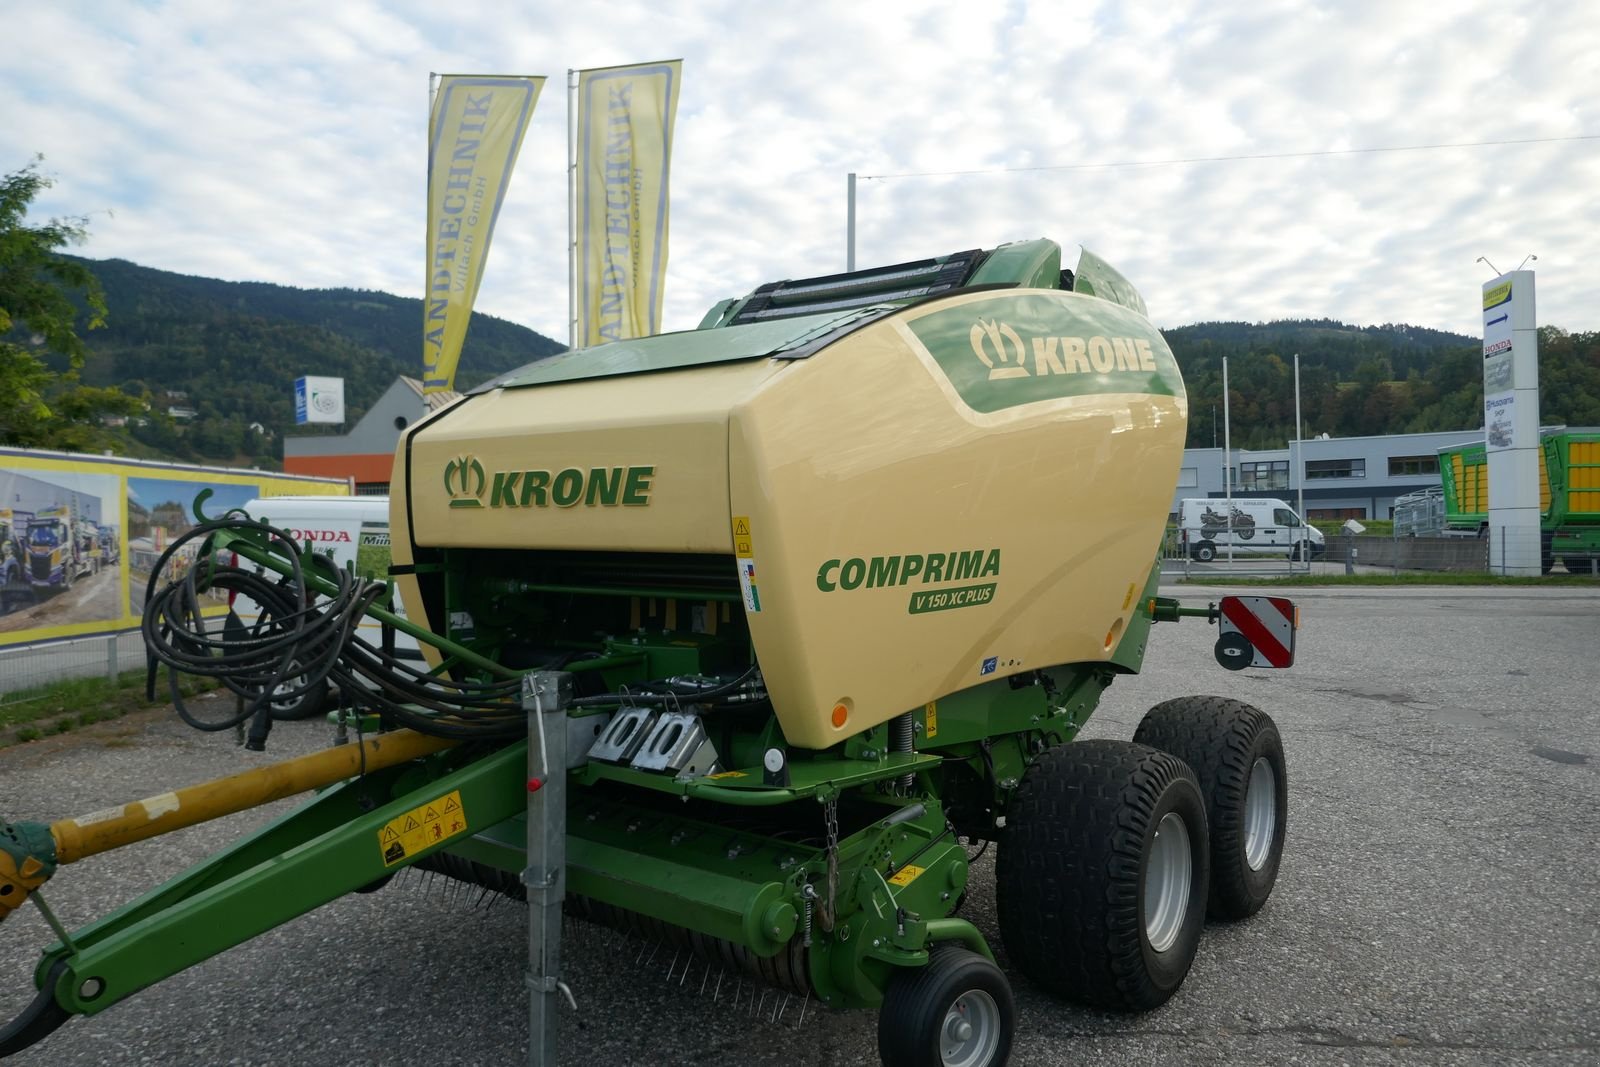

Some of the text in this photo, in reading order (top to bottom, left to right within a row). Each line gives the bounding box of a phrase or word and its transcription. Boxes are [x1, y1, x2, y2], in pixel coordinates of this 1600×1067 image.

[599, 82, 634, 341] ANDTECHNIK
[423, 91, 494, 375] LANDTECHNIK
[454, 176, 487, 292] Villach GmbH
[1032, 336, 1157, 376] KRONE
[1485, 339, 1512, 354] HONDA
[490, 465, 657, 507] KRONE
[271, 529, 352, 542] ONDA
[816, 549, 1001, 592] COMPRIMA
[916, 588, 992, 609] V 150 XC PLUS
